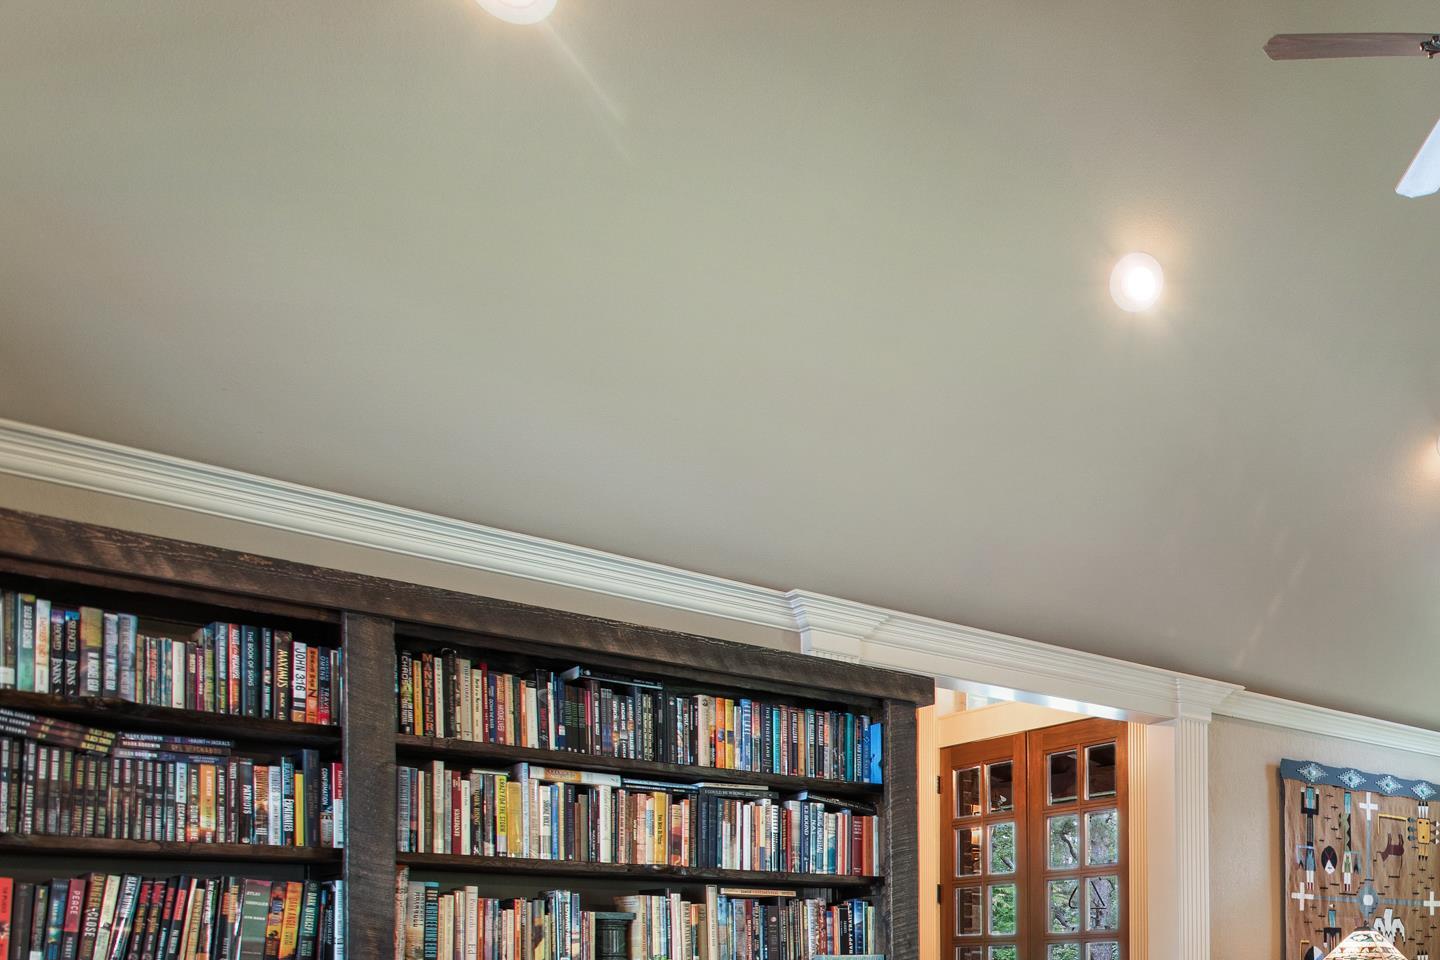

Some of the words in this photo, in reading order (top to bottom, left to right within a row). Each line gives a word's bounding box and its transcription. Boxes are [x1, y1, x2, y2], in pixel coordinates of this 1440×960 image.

[24, 605, 32, 618] DEAD
[51, 657, 63, 684] JENKINS
[66, 659, 77, 686] JENKINS
[277, 649, 288, 688] MAXIMUS
[295, 648, 306, 672] JOHN
[295, 673, 306, 691] 3:16
[423, 653, 432, 730] MANKILLER
[243, 784, 252, 814] PATRIOTS
[321, 768, 329, 805] CONFIRMATION
[190, 805, 198, 823] GOING
[69, 890, 81, 915] PEACE
[308, 892, 317, 905] DARK
[84, 911, 97, 937] CLOSE
[304, 907, 315, 934] INTERCEPT
[425, 903, 437, 941] ENGINEERING
[425, 943, 437, 958] EDEN
[468, 944, 477, 954] Ed
